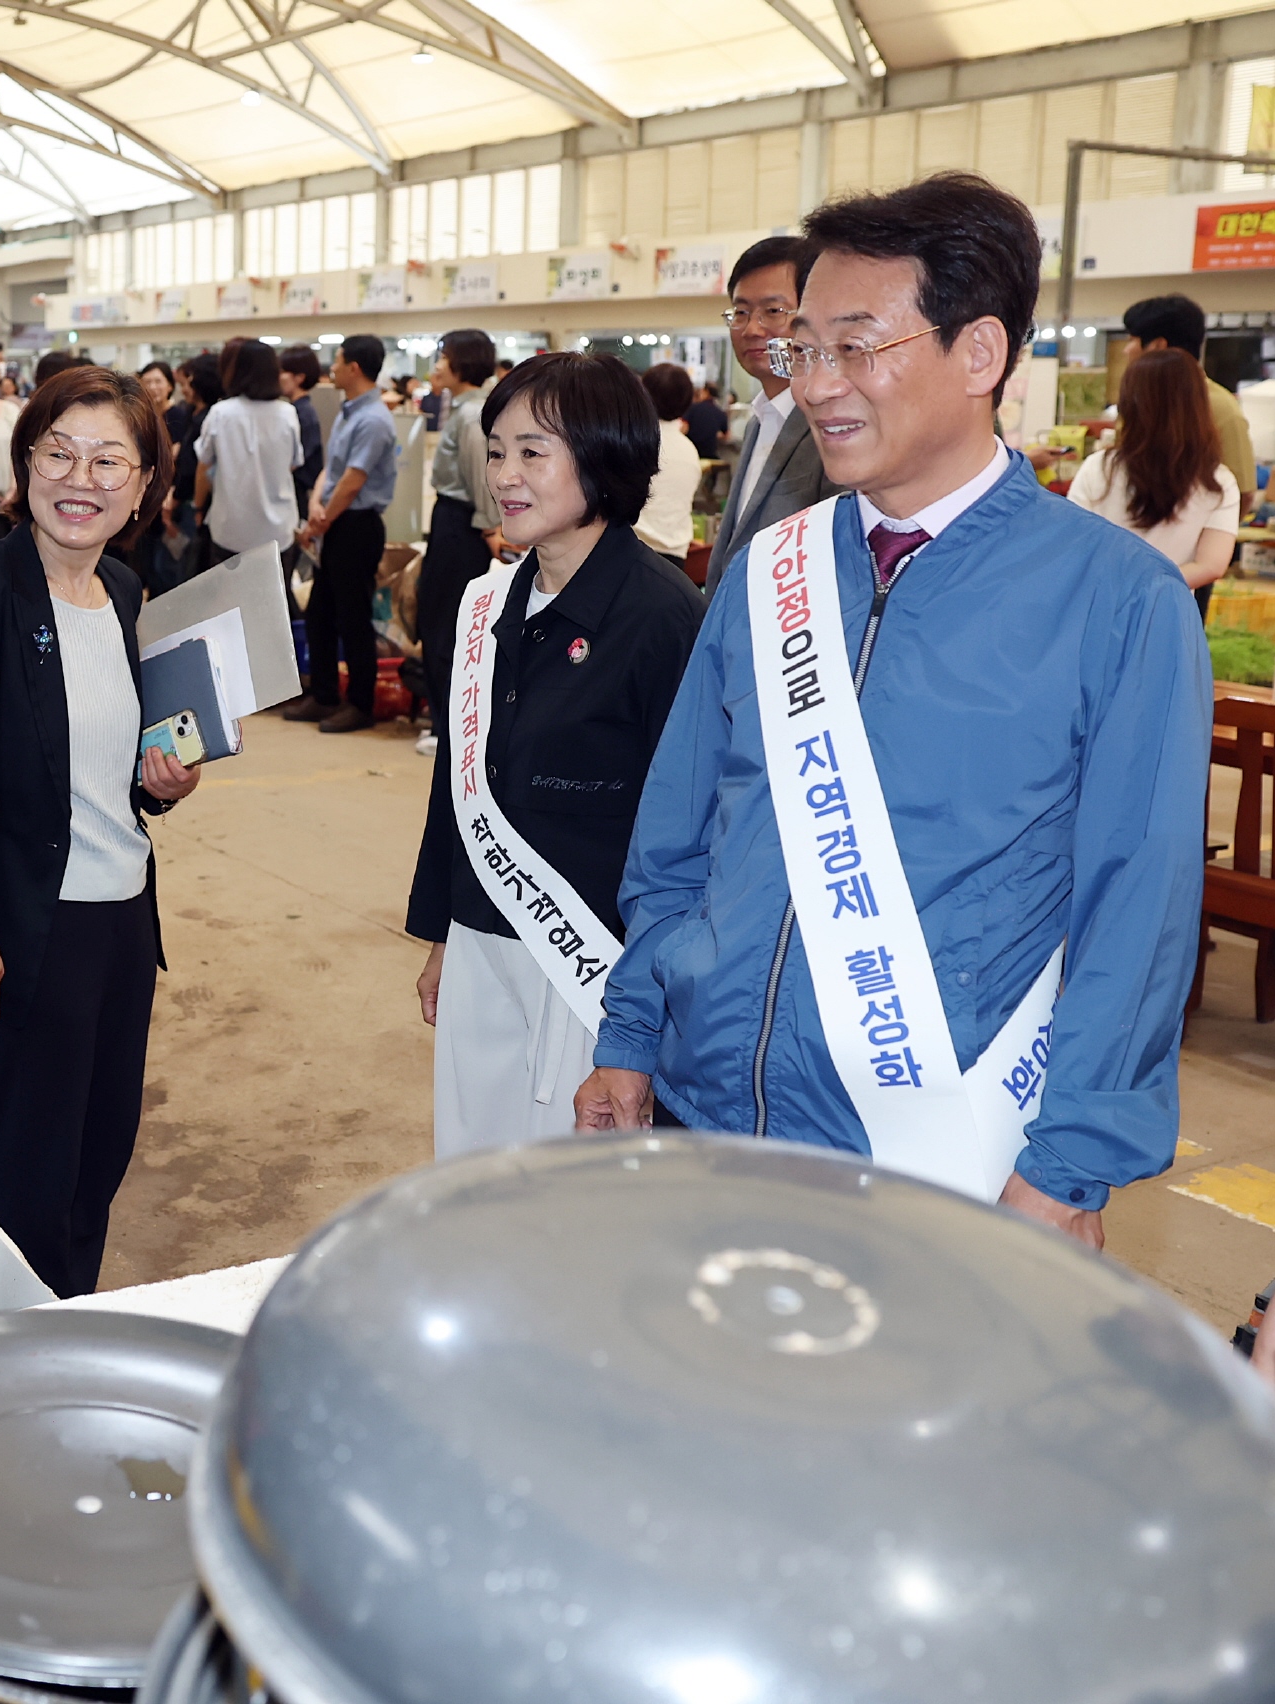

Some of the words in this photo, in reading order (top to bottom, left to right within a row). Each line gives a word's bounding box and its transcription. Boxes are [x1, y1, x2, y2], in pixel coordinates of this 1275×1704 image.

[772, 507, 826, 718] 가안정으로
[470, 812, 609, 987] 착한가격업소
[795, 729, 880, 920] 지역경제
[845, 945, 923, 1088] 활성화
